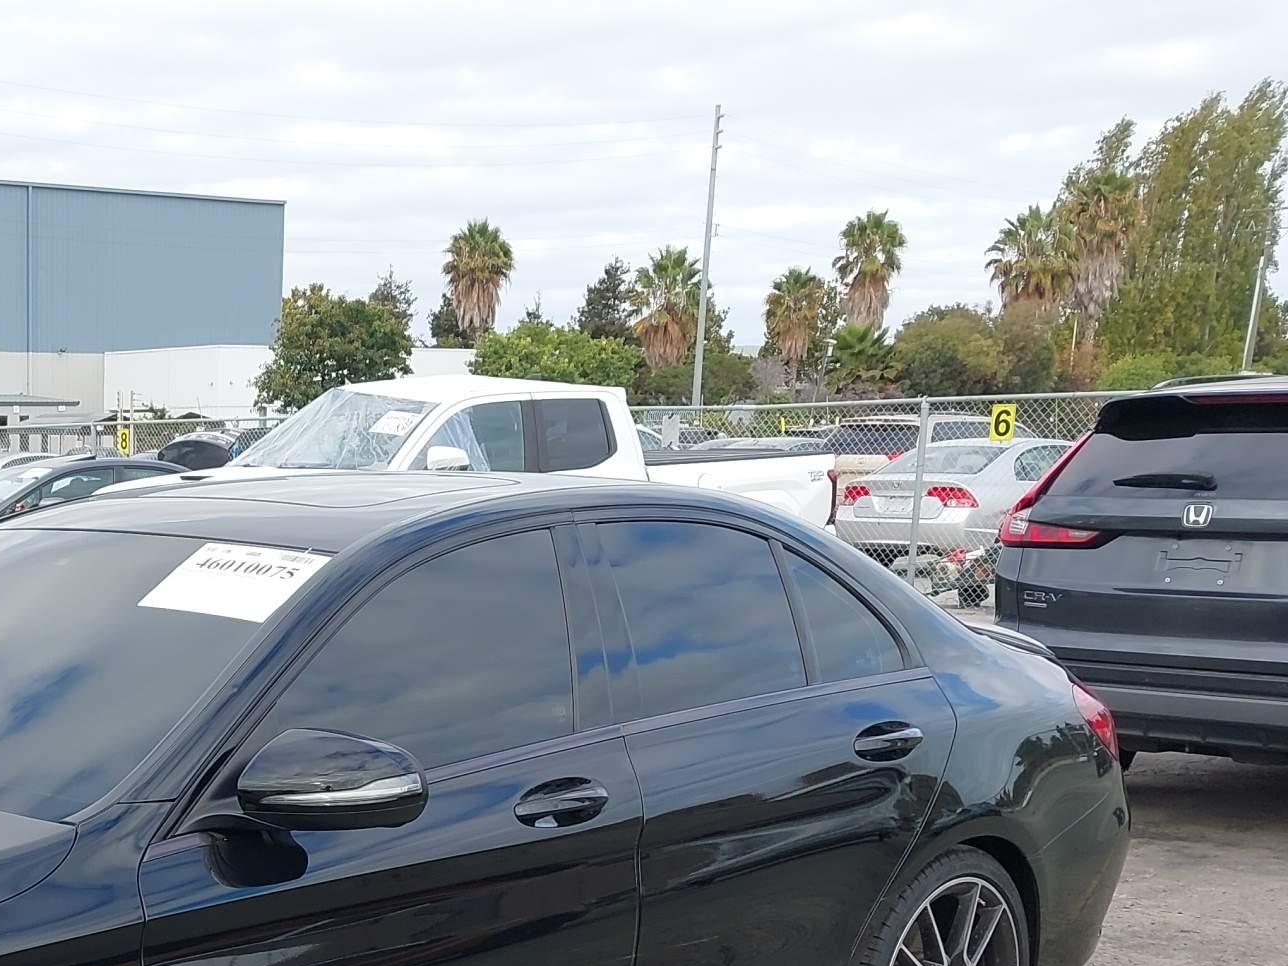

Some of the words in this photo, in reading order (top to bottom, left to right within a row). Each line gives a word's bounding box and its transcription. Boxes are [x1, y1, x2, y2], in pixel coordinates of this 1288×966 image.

[993, 409, 1012, 437] 6
[120, 431, 128, 450] 8
[196, 557, 300, 580] 46010075
[1023, 590, 1063, 602] CR-V
